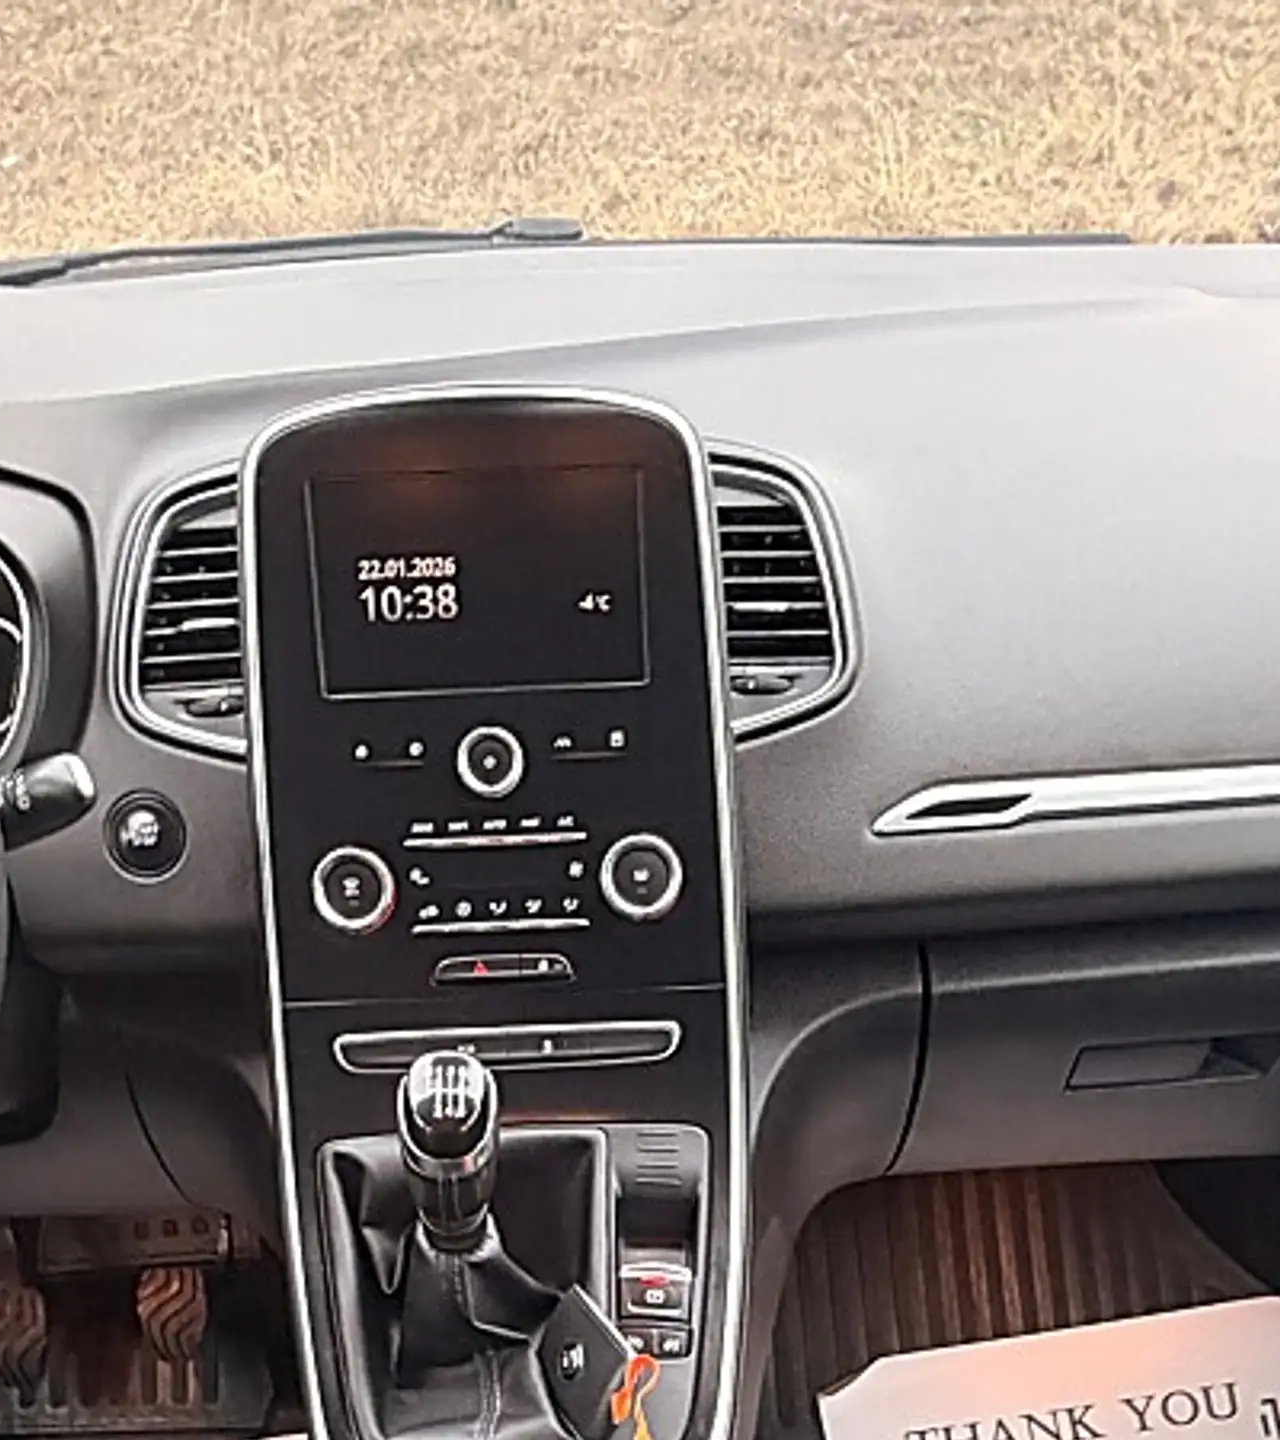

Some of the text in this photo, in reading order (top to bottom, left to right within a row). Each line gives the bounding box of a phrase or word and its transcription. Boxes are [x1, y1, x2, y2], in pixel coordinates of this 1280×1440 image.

[358, 556, 456, 581] 22.01.2026
[358, 584, 458, 622] 10:38
[1122, 1382, 1240, 1432] YOU
